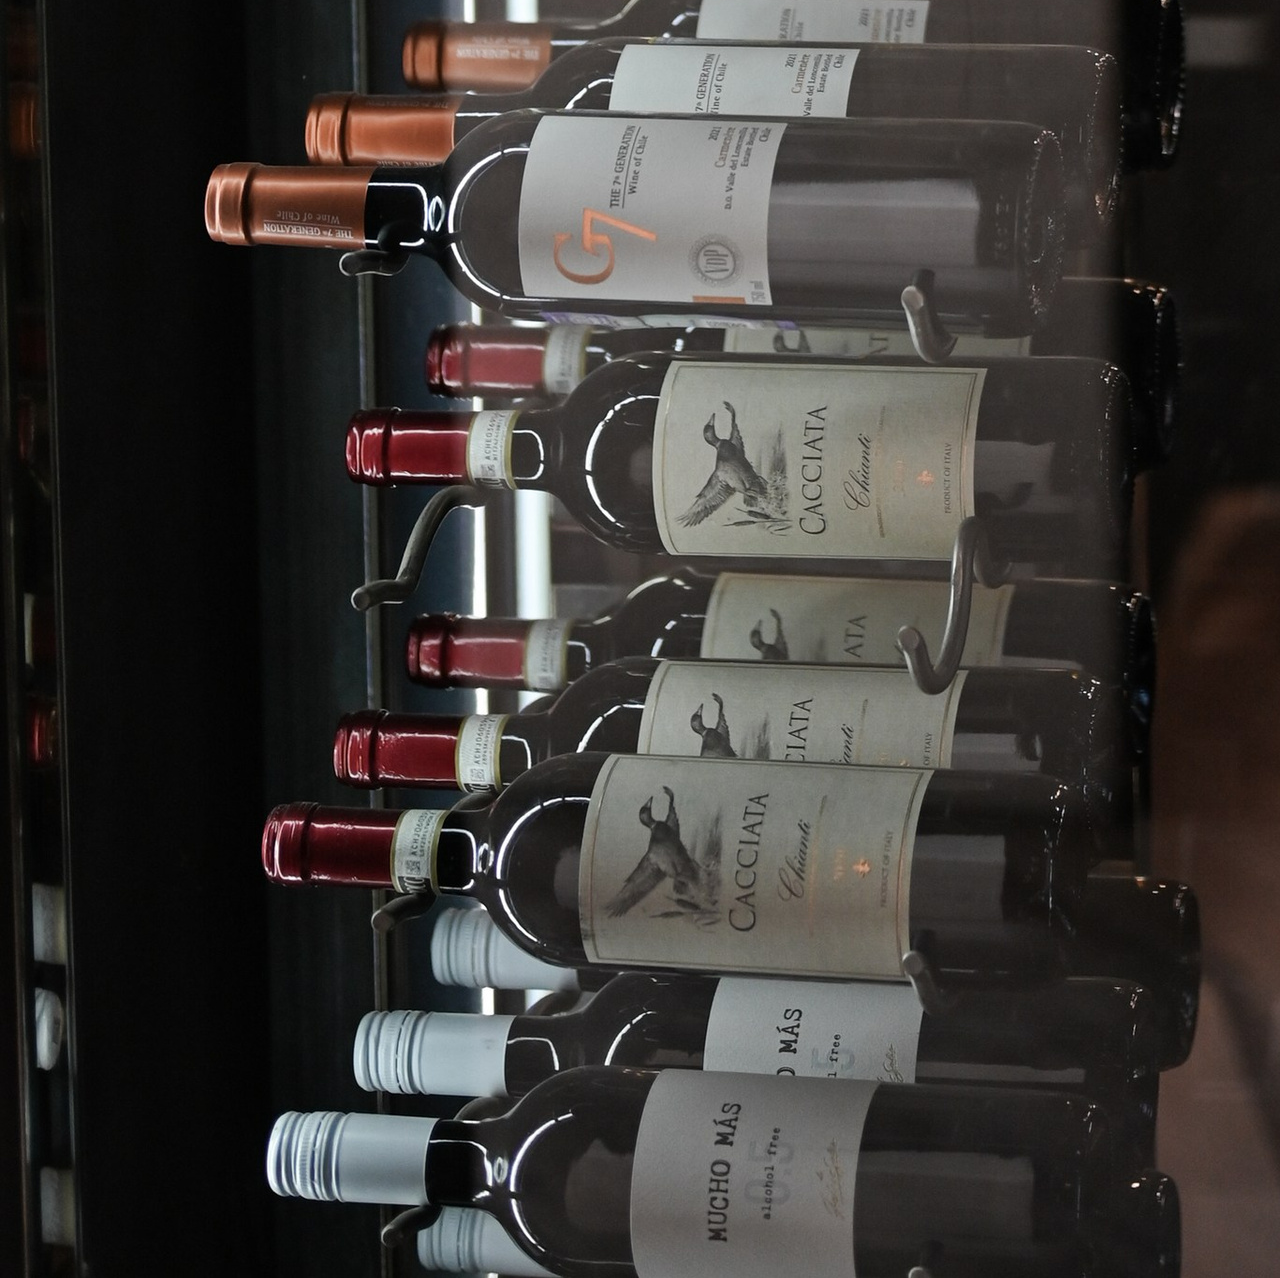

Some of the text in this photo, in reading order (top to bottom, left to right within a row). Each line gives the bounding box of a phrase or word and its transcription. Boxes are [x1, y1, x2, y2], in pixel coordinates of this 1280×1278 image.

[694, 52, 717, 100] GENERATION
[712, 62, 728, 94] of Chile
[784, 53, 797, 68] 2021
[791, 53, 811, 94] Carmenère
[817, 73, 828, 93] Estate
[833, 54, 846, 69] Chile
[803, 53, 823, 117] Valle del Loncomilla
[758, 127, 772, 143] Chile
[609, 125, 637, 209] THE 7th GENERATION
[627, 134, 649, 195] Wine of Chile
[724, 172, 739, 193] Valle
[263, 222, 322, 235] GENERATION
[276, 209, 341, 225] Wine of Chile
[552, 207, 658, 285] G7
[702, 249, 730, 274] VDP
[798, 404, 828, 535] CACCIATA
[843, 432, 872, 511] Chianti
[943, 442, 952, 514] PRODUCT ITALY
[728, 791, 770, 933] CACCIATA
[776, 819, 812, 902] Chianti
[776, 1008, 803, 1054] MÁS
[828, 1034, 842, 1063] free
[706, 1102, 742, 1242] MUCHO MÁS
[761, 1127, 781, 1220] alcohol free
